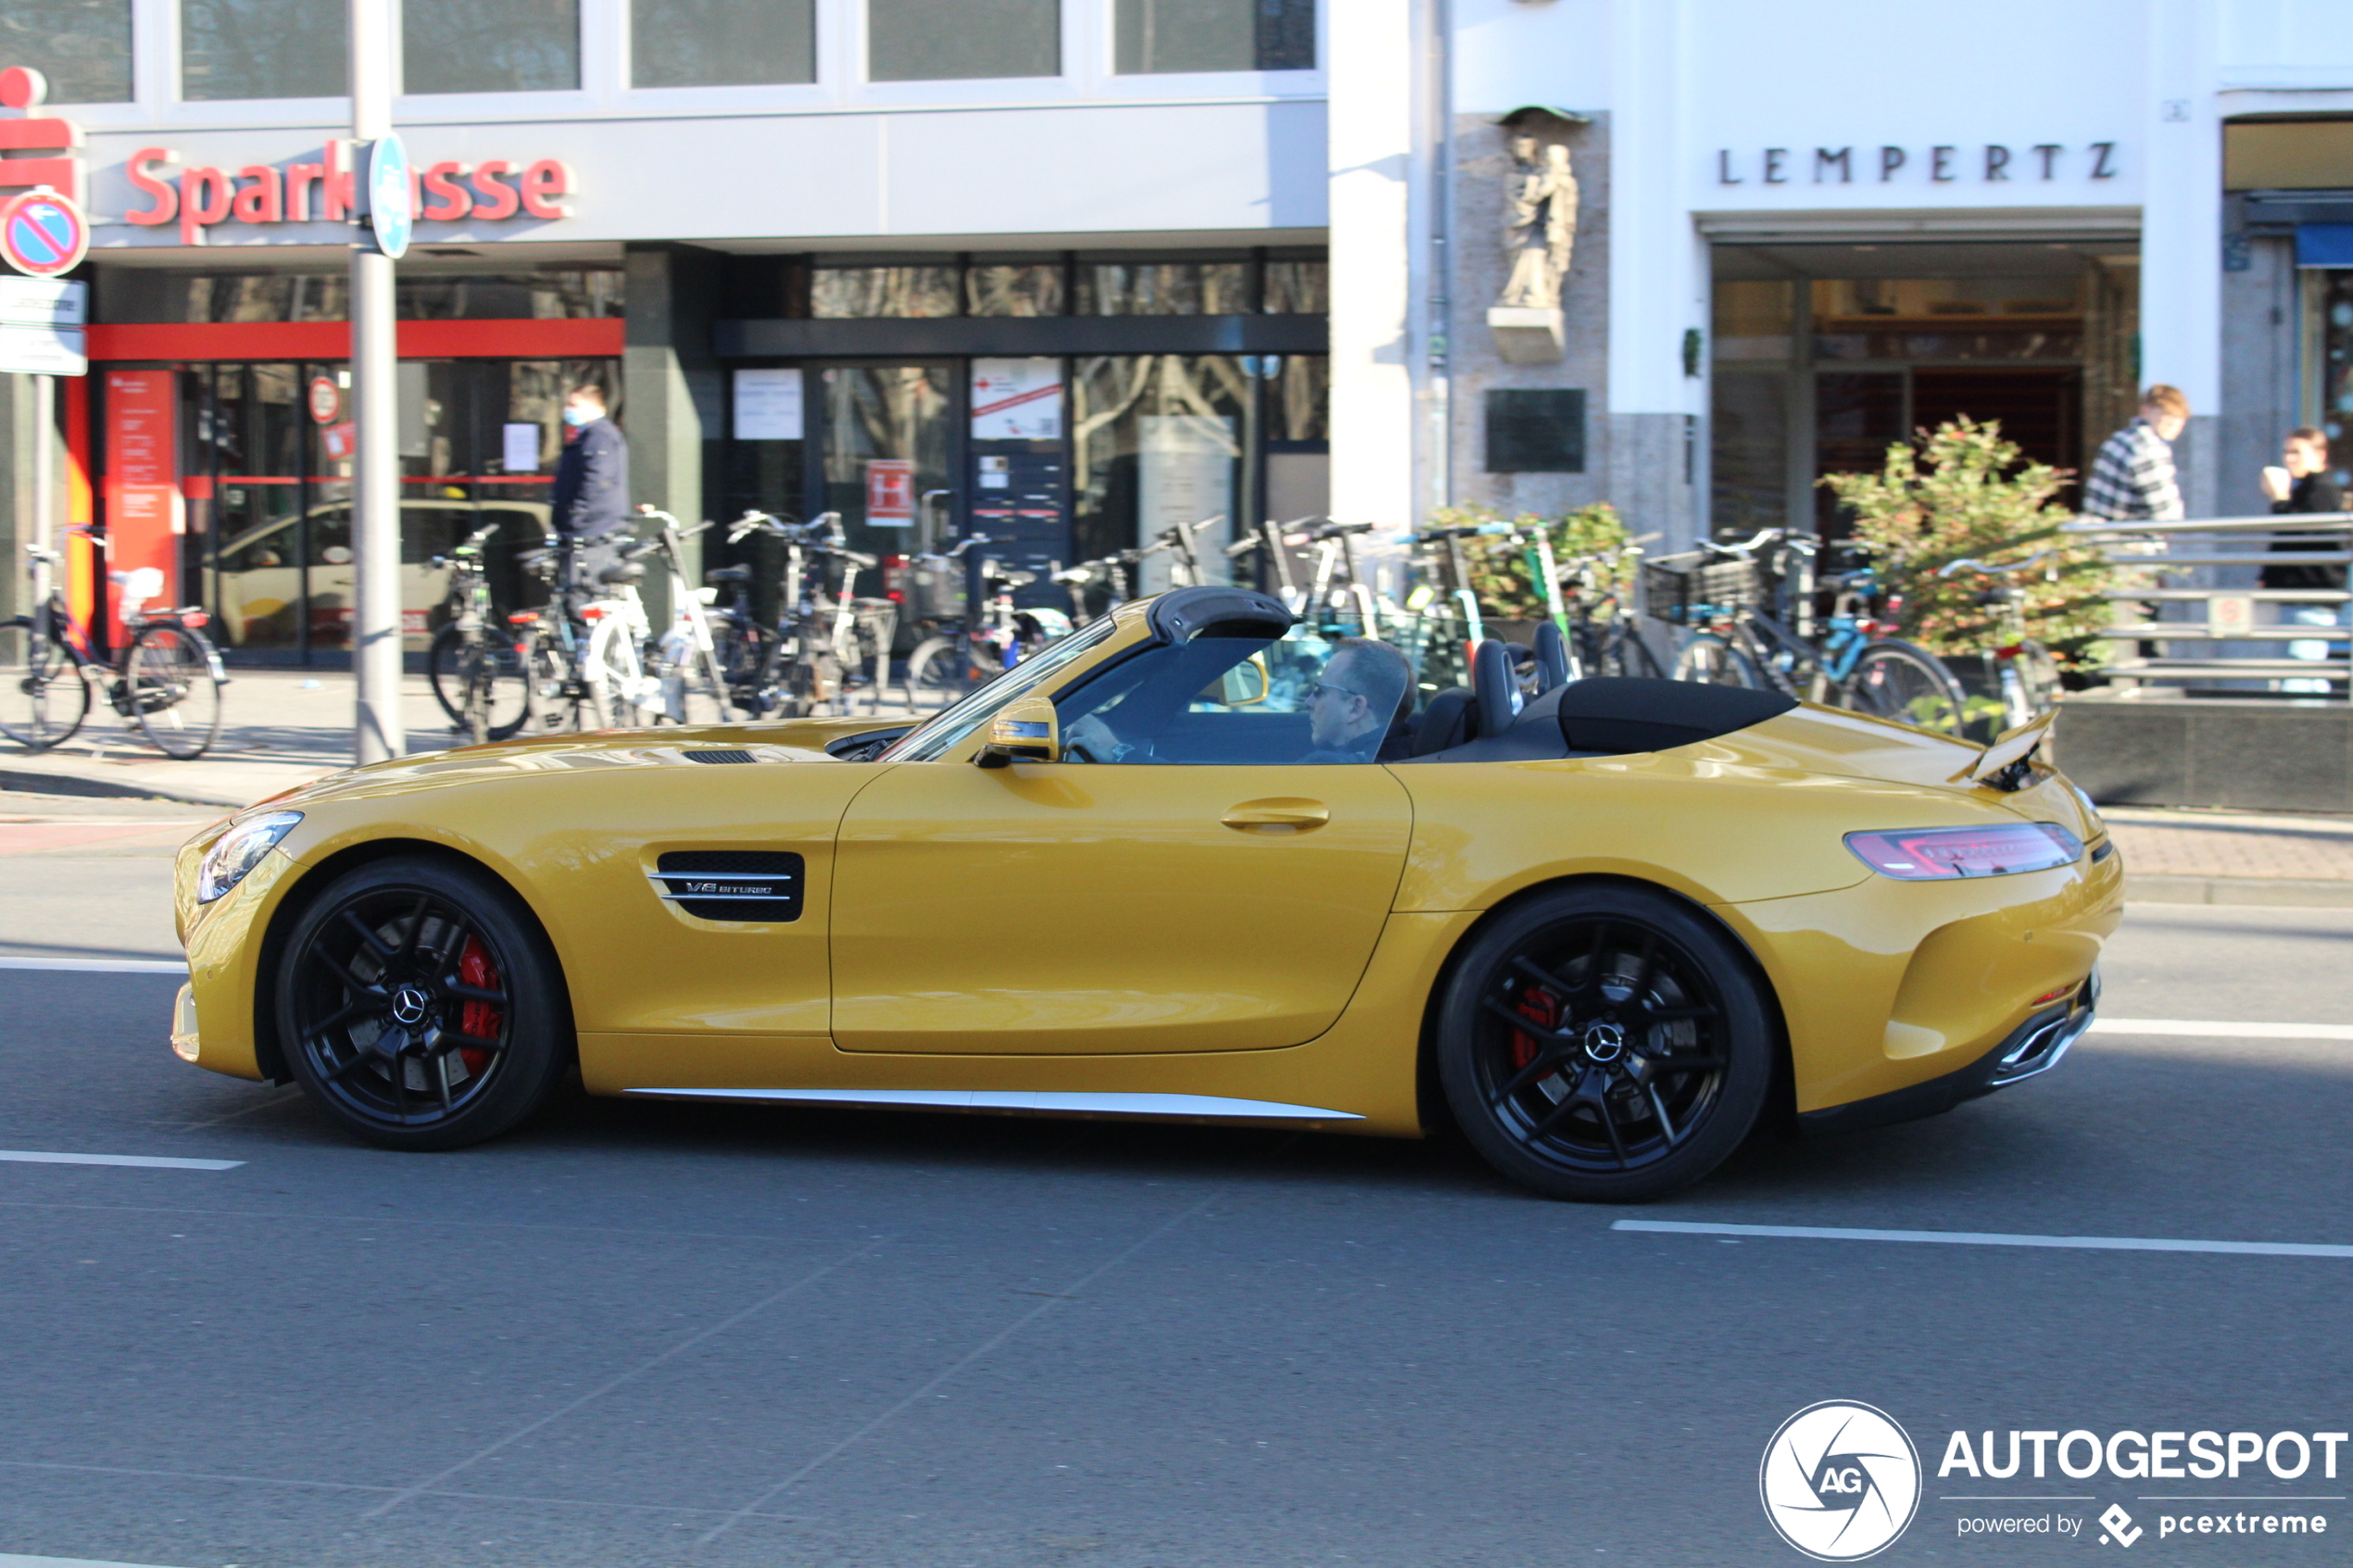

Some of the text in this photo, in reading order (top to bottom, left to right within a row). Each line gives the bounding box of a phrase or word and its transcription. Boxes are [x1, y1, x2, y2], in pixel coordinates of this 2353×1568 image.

[1718, 142, 2118, 185] LEMPERTZ
[124, 139, 575, 245] Sparksse
[686, 882, 773, 894] V8 BITURBO
